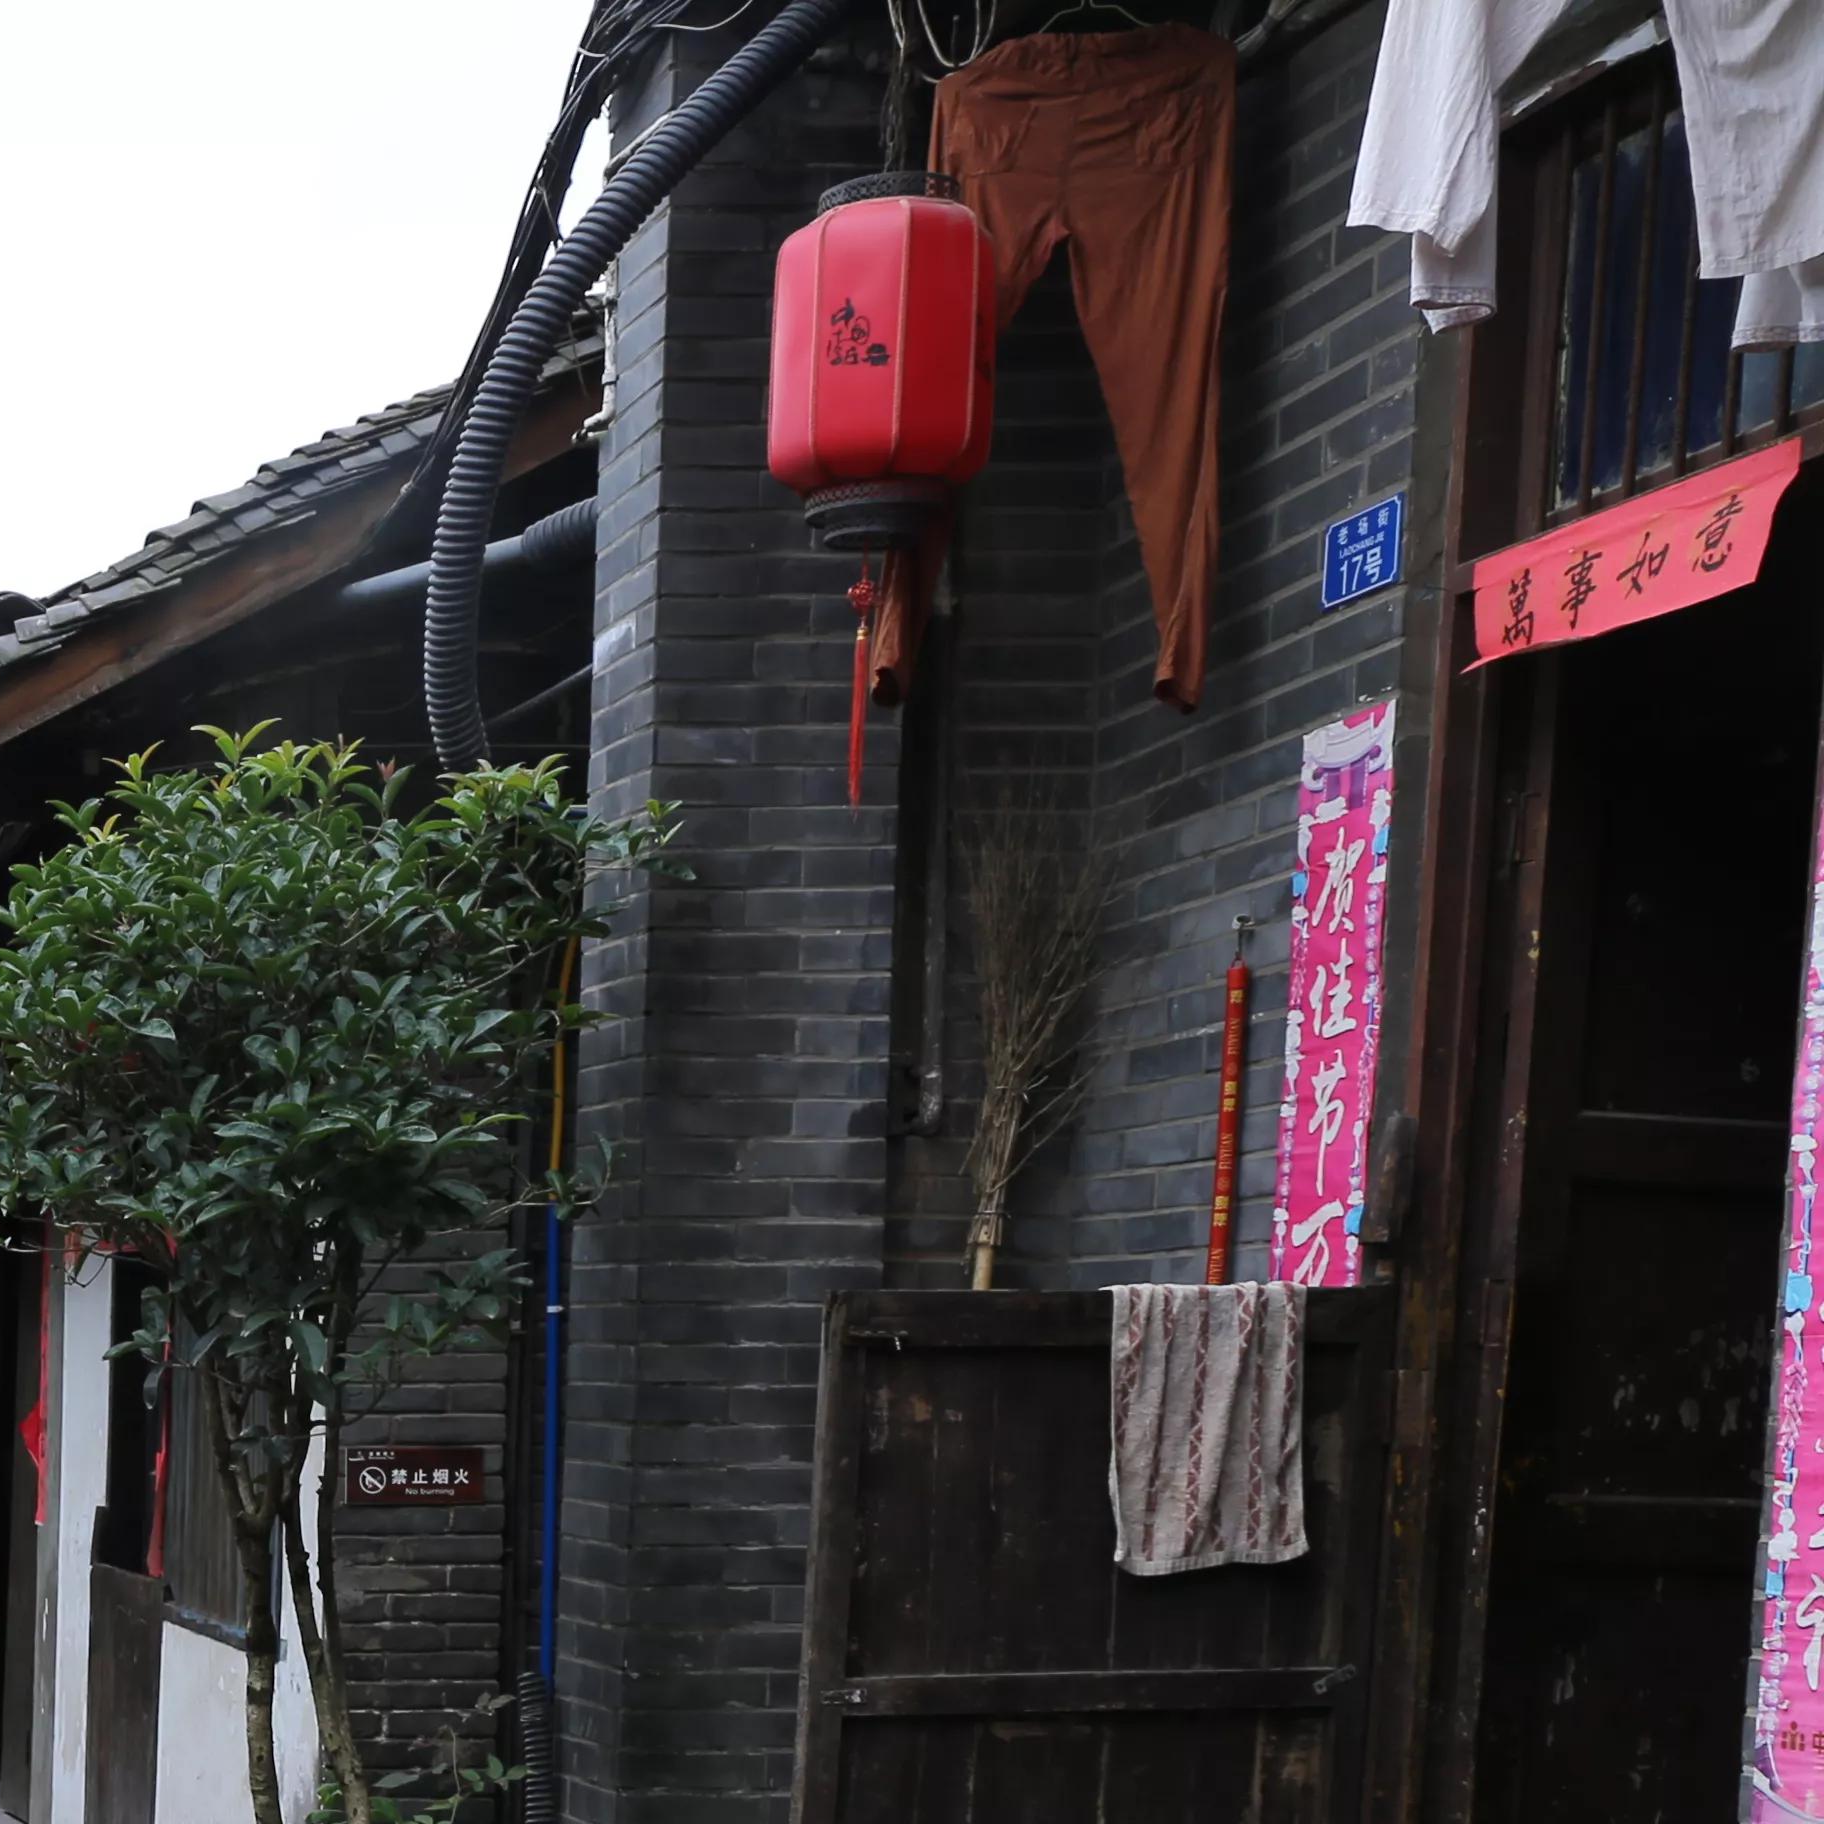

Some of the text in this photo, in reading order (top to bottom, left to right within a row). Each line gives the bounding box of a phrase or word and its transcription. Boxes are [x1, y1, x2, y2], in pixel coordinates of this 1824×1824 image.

[1340, 546, 1383, 596] 17号
[1502, 495, 1744, 645] 萬事如意
[391, 1468, 470, 1485] 禁止烟火
[405, 1488, 455, 1497] No burning
